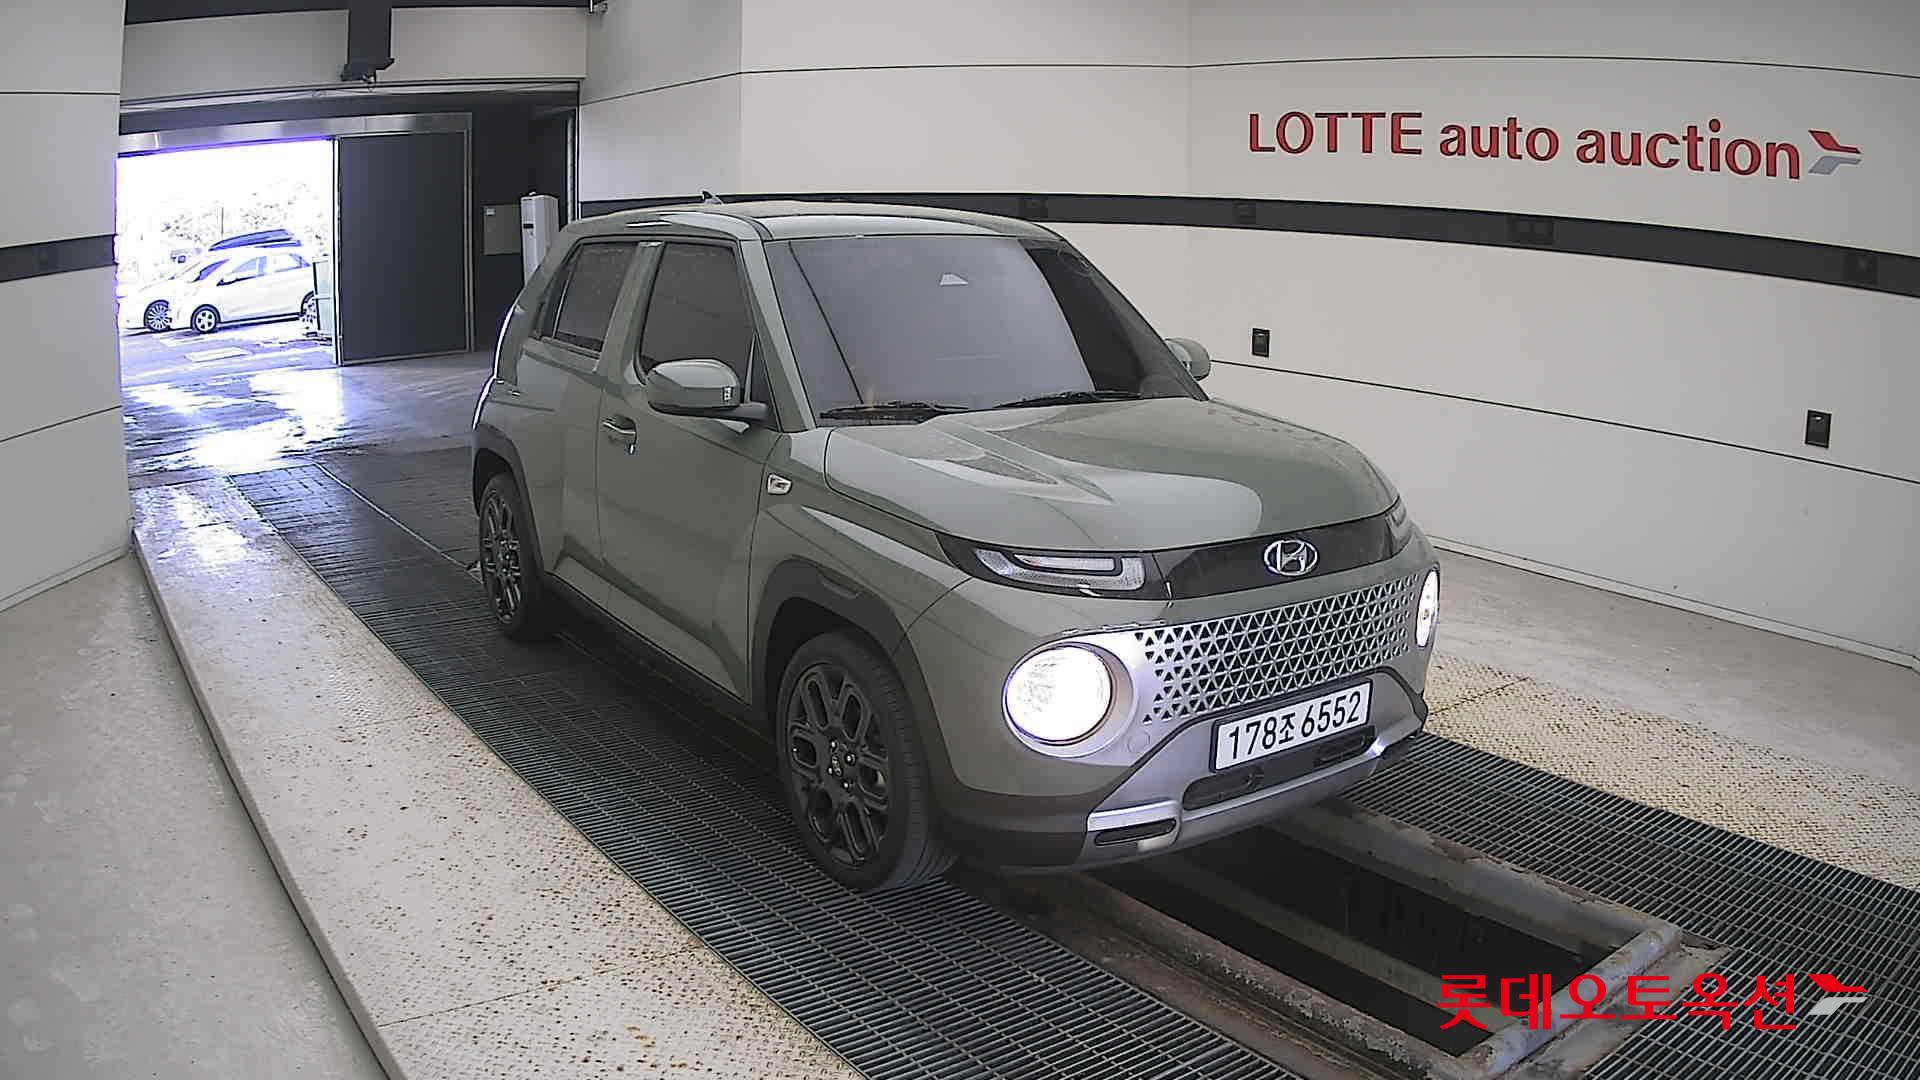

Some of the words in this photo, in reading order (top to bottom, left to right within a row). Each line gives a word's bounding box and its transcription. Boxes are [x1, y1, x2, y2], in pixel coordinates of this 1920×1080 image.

[1249, 111, 1424, 155] LOTTE
[1439, 117, 1560, 162] auto
[1576, 118, 1802, 180] auction
[1229, 711, 1296, 760] 178조
[1301, 691, 1361, 738] 6552
